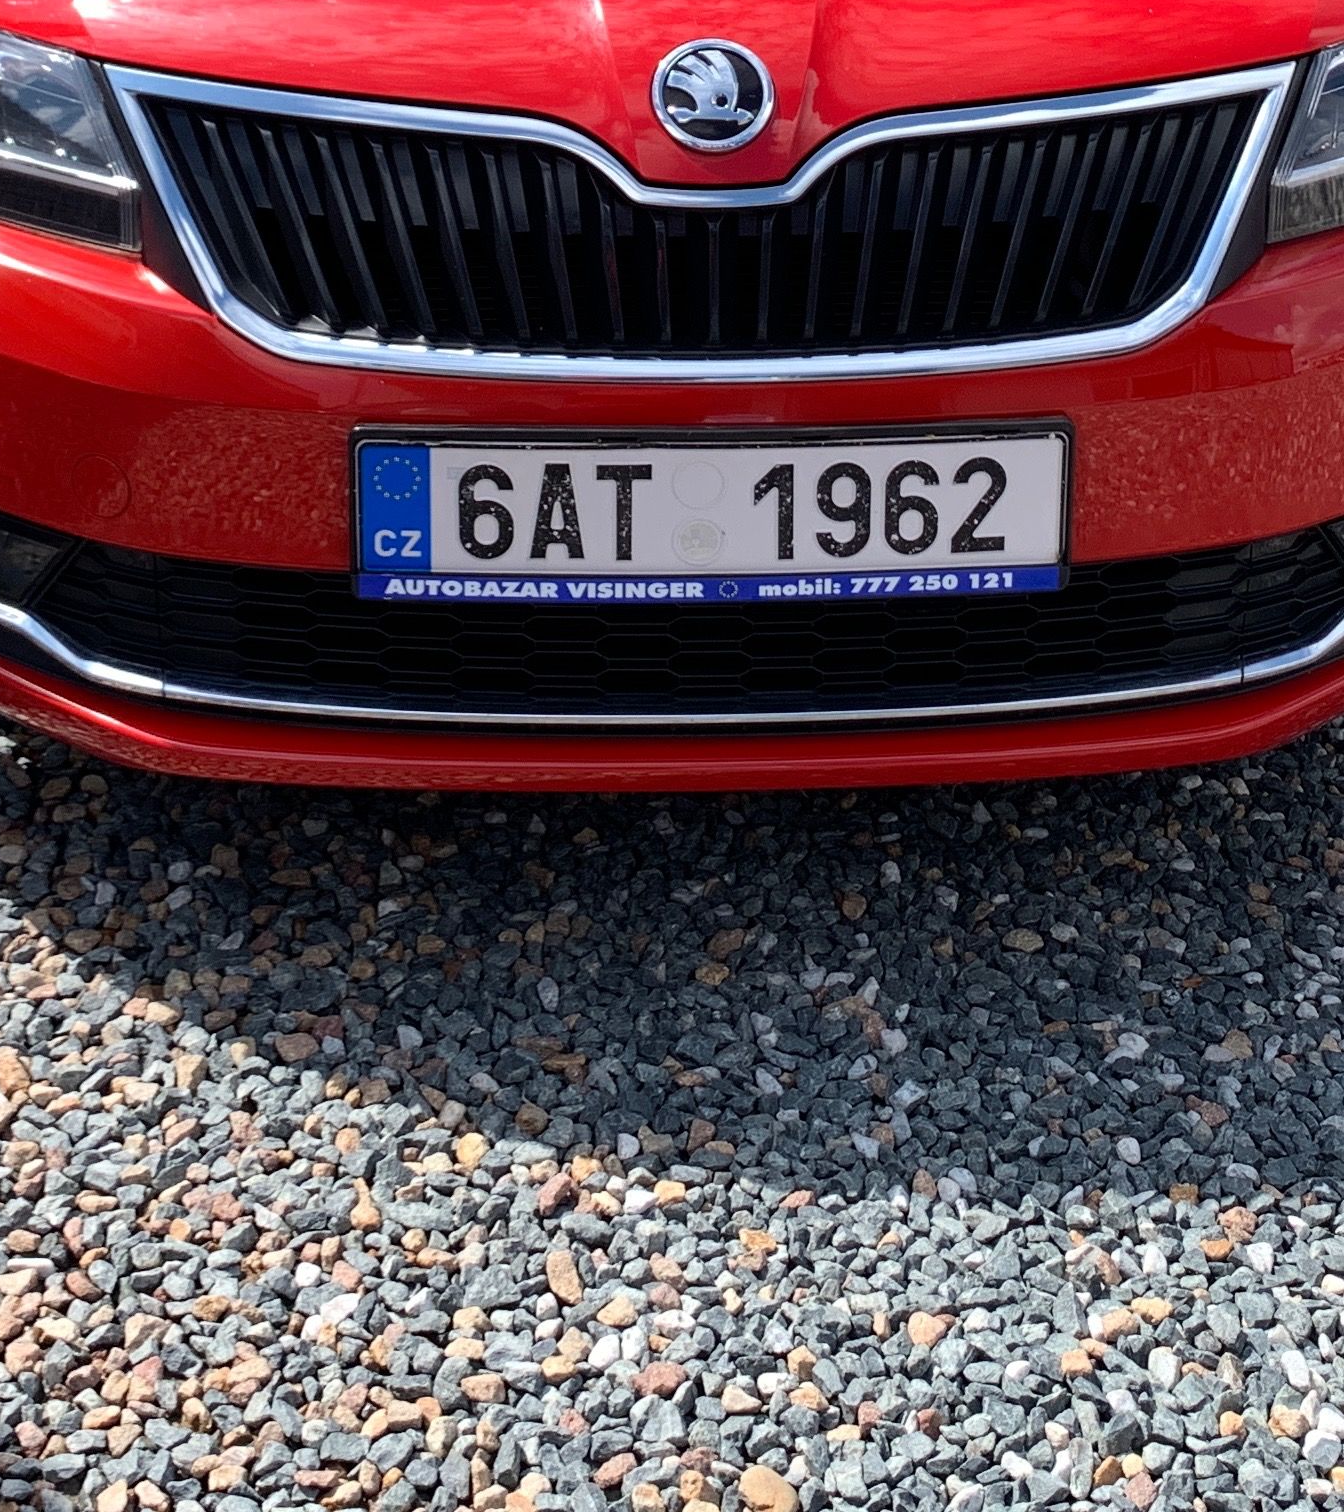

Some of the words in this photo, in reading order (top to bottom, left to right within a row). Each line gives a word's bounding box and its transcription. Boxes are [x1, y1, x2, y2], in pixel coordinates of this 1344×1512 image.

[457, 462, 654, 562] 6AT
[753, 456, 1009, 561] 1962
[373, 529, 423, 558] CZ
[383, 577, 560, 600] AUTOBAZAR
[566, 581, 705, 601] VISINGER
[758, 577, 842, 597] mobil:
[849, 575, 902, 594] 777
[908, 573, 959, 592] 250
[968, 571, 1015, 589] 121
